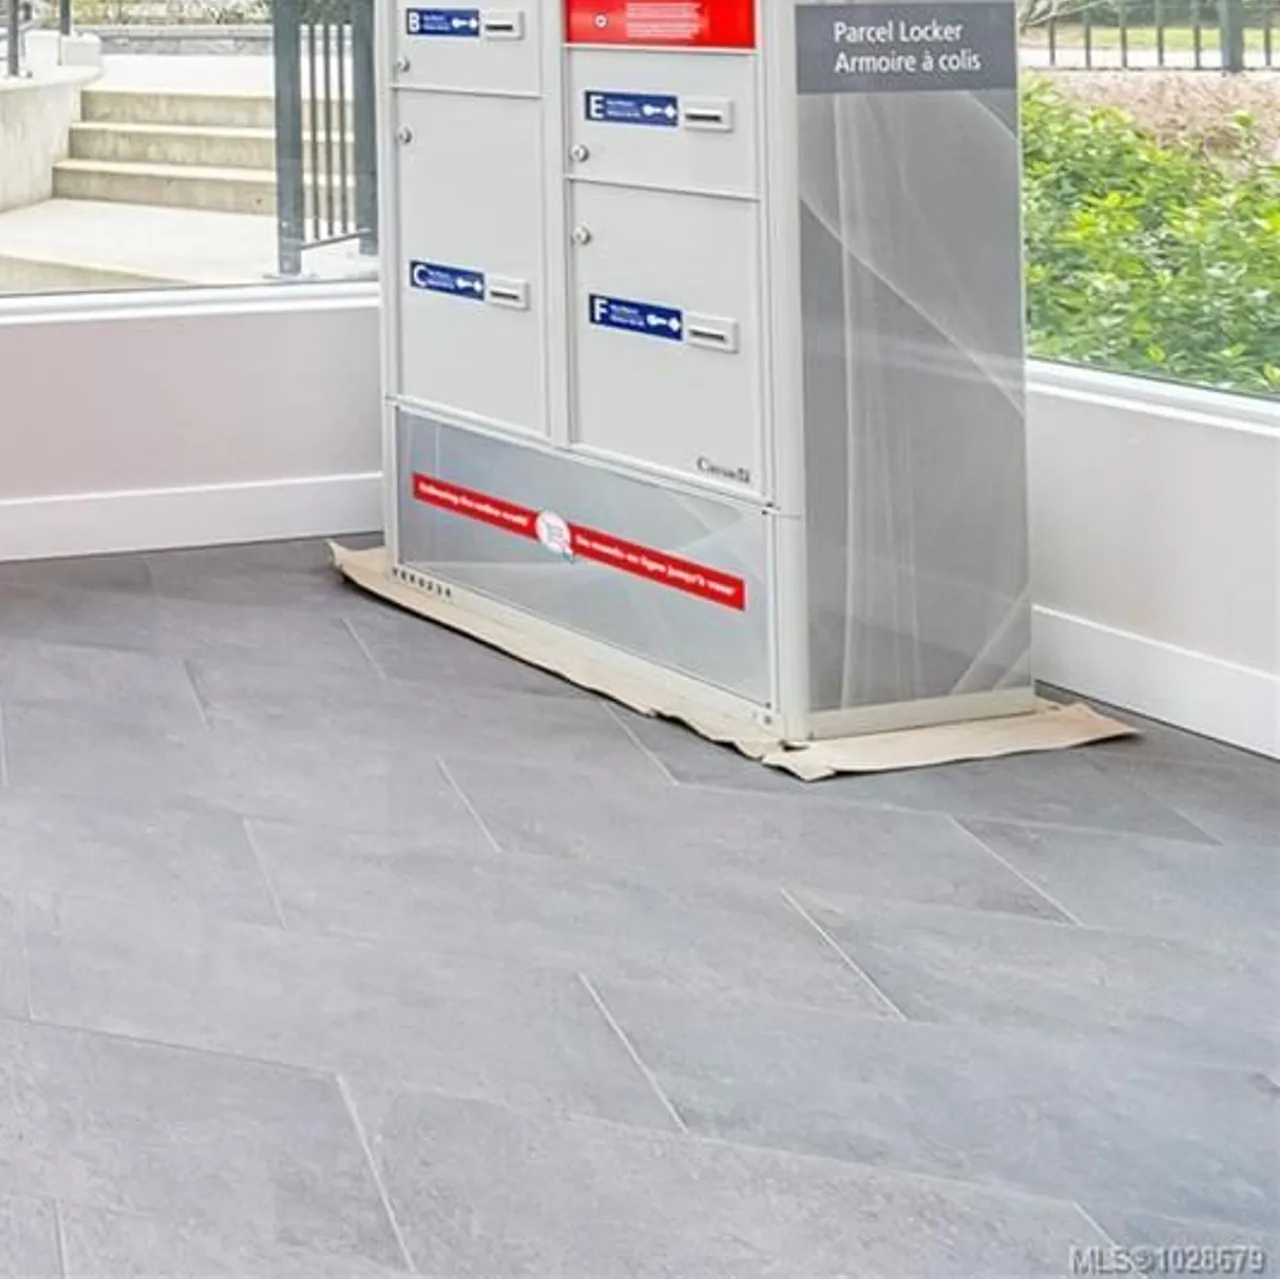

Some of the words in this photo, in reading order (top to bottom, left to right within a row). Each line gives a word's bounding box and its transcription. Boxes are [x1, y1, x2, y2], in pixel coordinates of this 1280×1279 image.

[408, 11, 421, 33] B
[833, 20, 894, 43] Parcel
[899, 19, 963, 42] Locker
[834, 49, 918, 73] Armoire
[921, 50, 935, 72] à
[938, 47, 982, 71] colis
[590, 95, 604, 119] E
[413, 264, 428, 288] C
[594, 298, 608, 322] F
